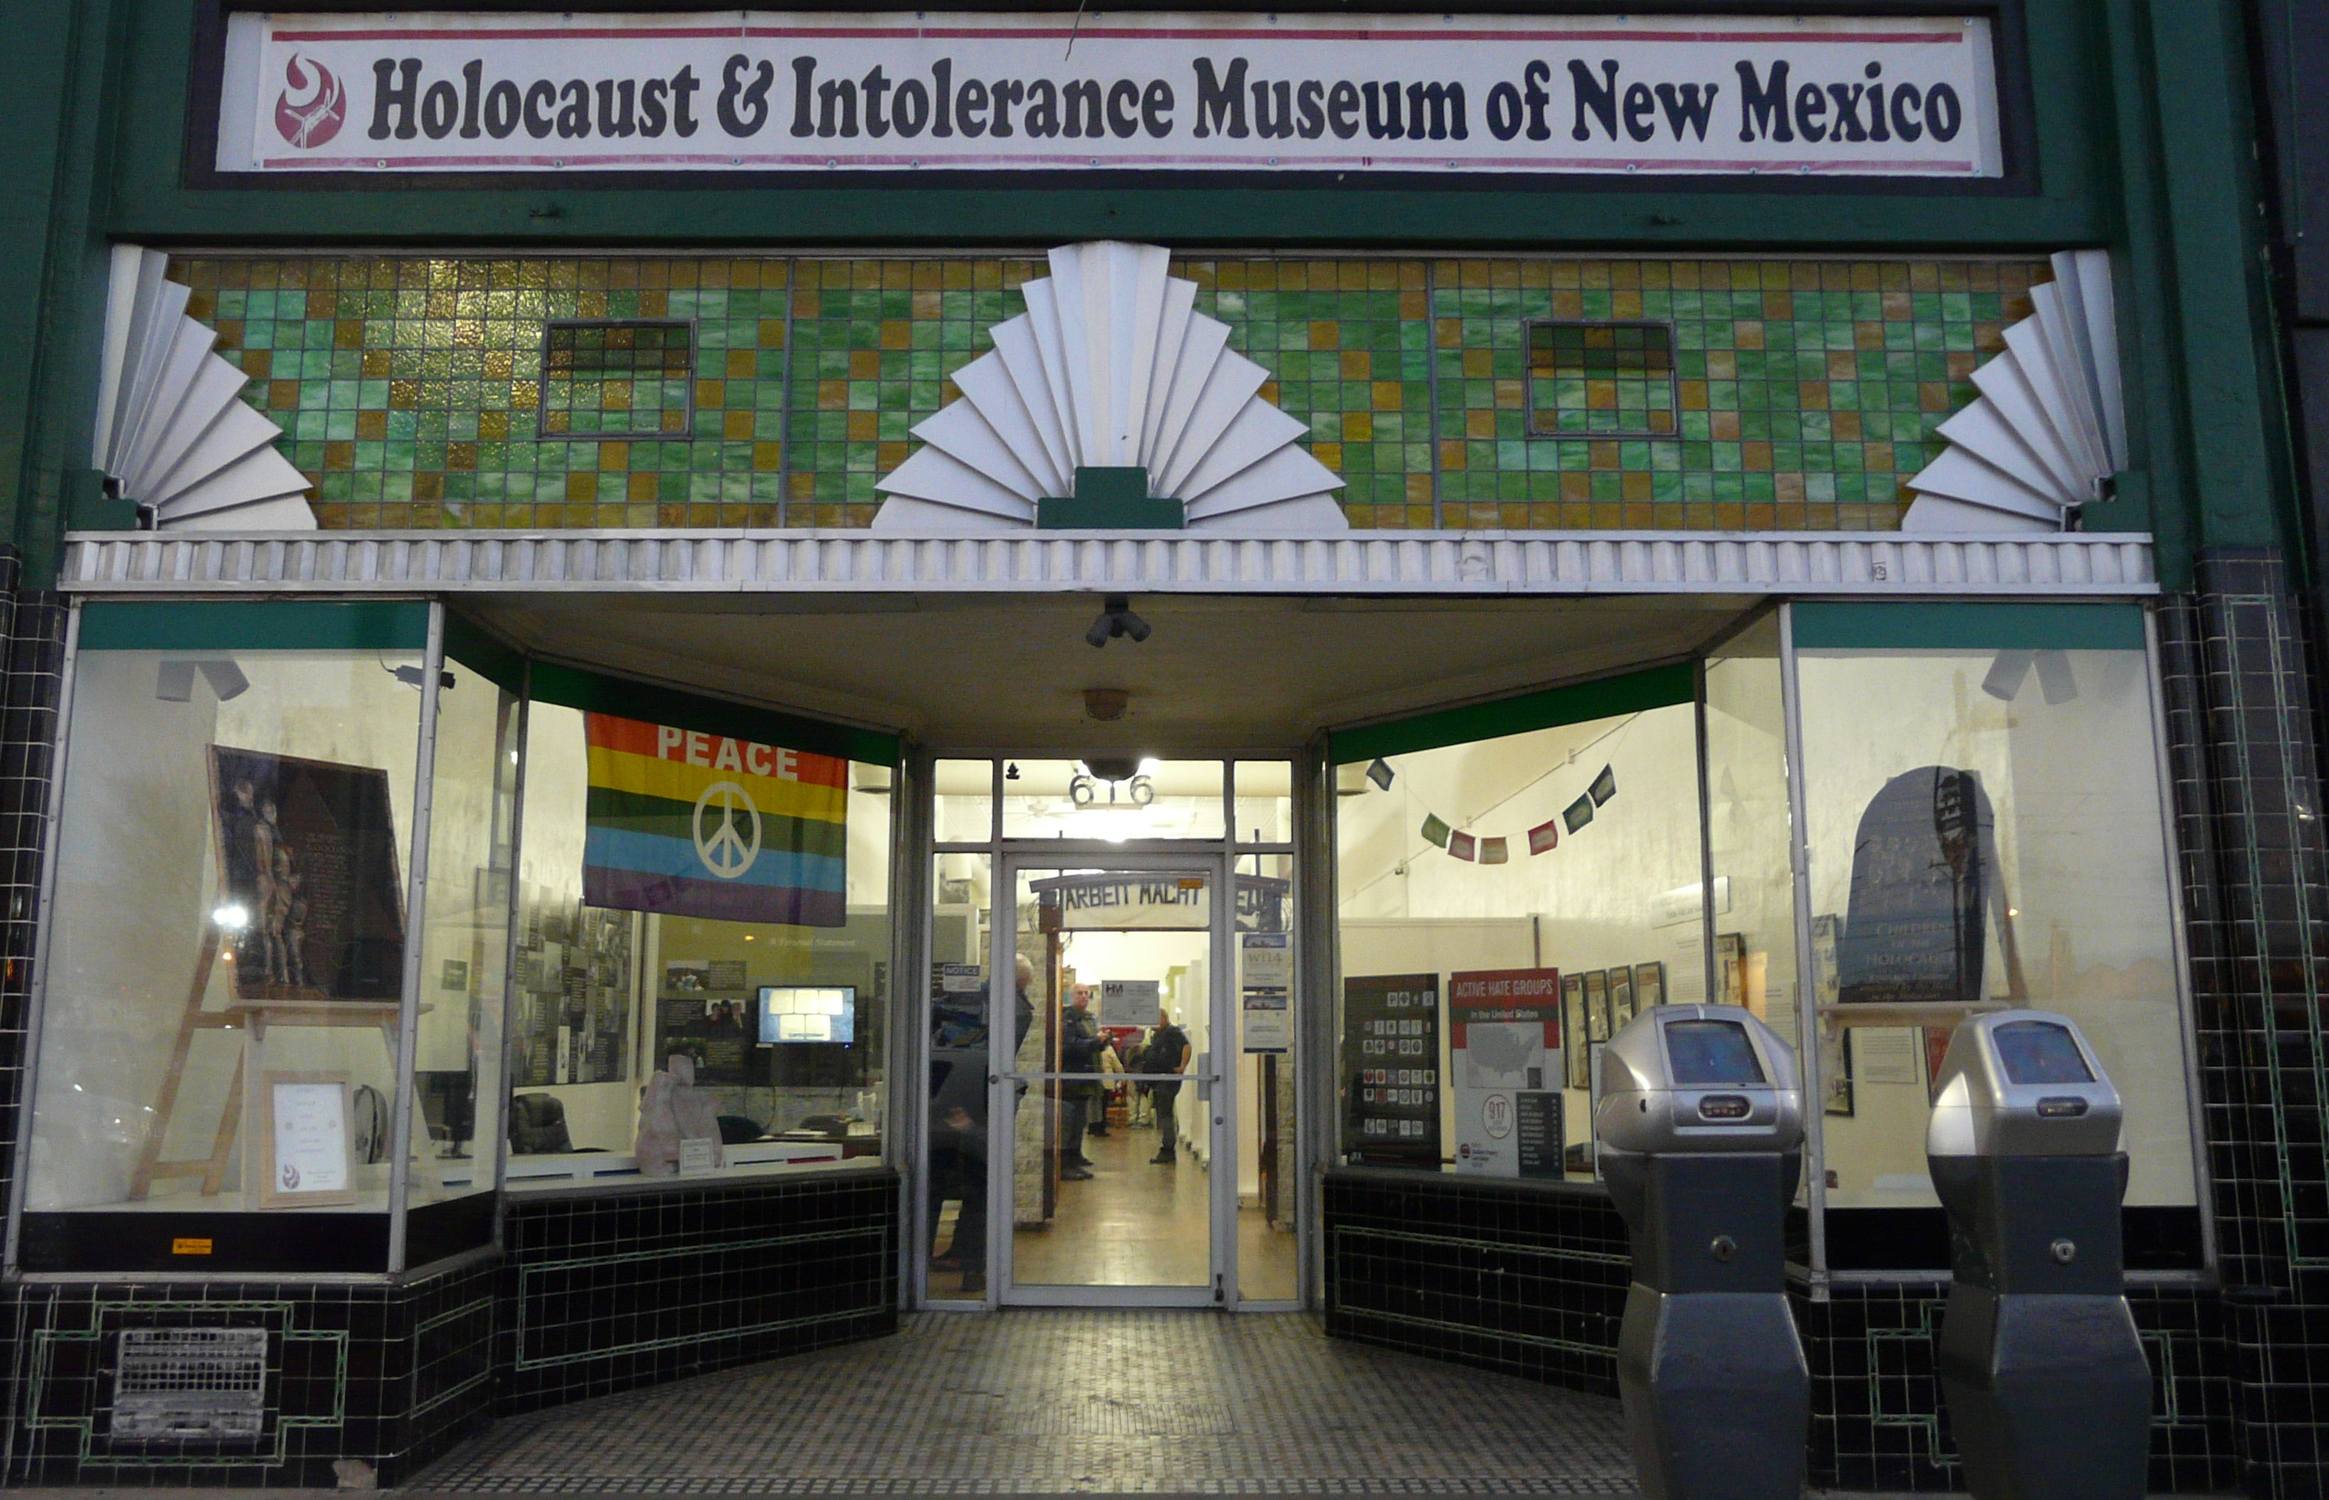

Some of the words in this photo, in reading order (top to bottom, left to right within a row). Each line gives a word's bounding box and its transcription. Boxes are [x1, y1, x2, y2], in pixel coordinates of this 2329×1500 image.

[368, 57, 700, 140] Holocaust
[717, 53, 774, 139] &
[790, 55, 1175, 139] Intolerance
[1192, 57, 1469, 141] Museum
[1485, 59, 1551, 142] of
[1568, 59, 1719, 143] New
[1735, 60, 1962, 143] Mexico
[656, 725, 799, 781] PEACE
[1069, 774, 1154, 806] 616
[1065, 884, 1130, 911] ARBEIT
[1140, 884, 1201, 907] MACHT
[1456, 980, 1487, 998] ACTIVE
[1488, 979, 1511, 997] HATE
[1513, 978, 1554, 996] GROUPS
[1488, 1101, 1506, 1120] 917
